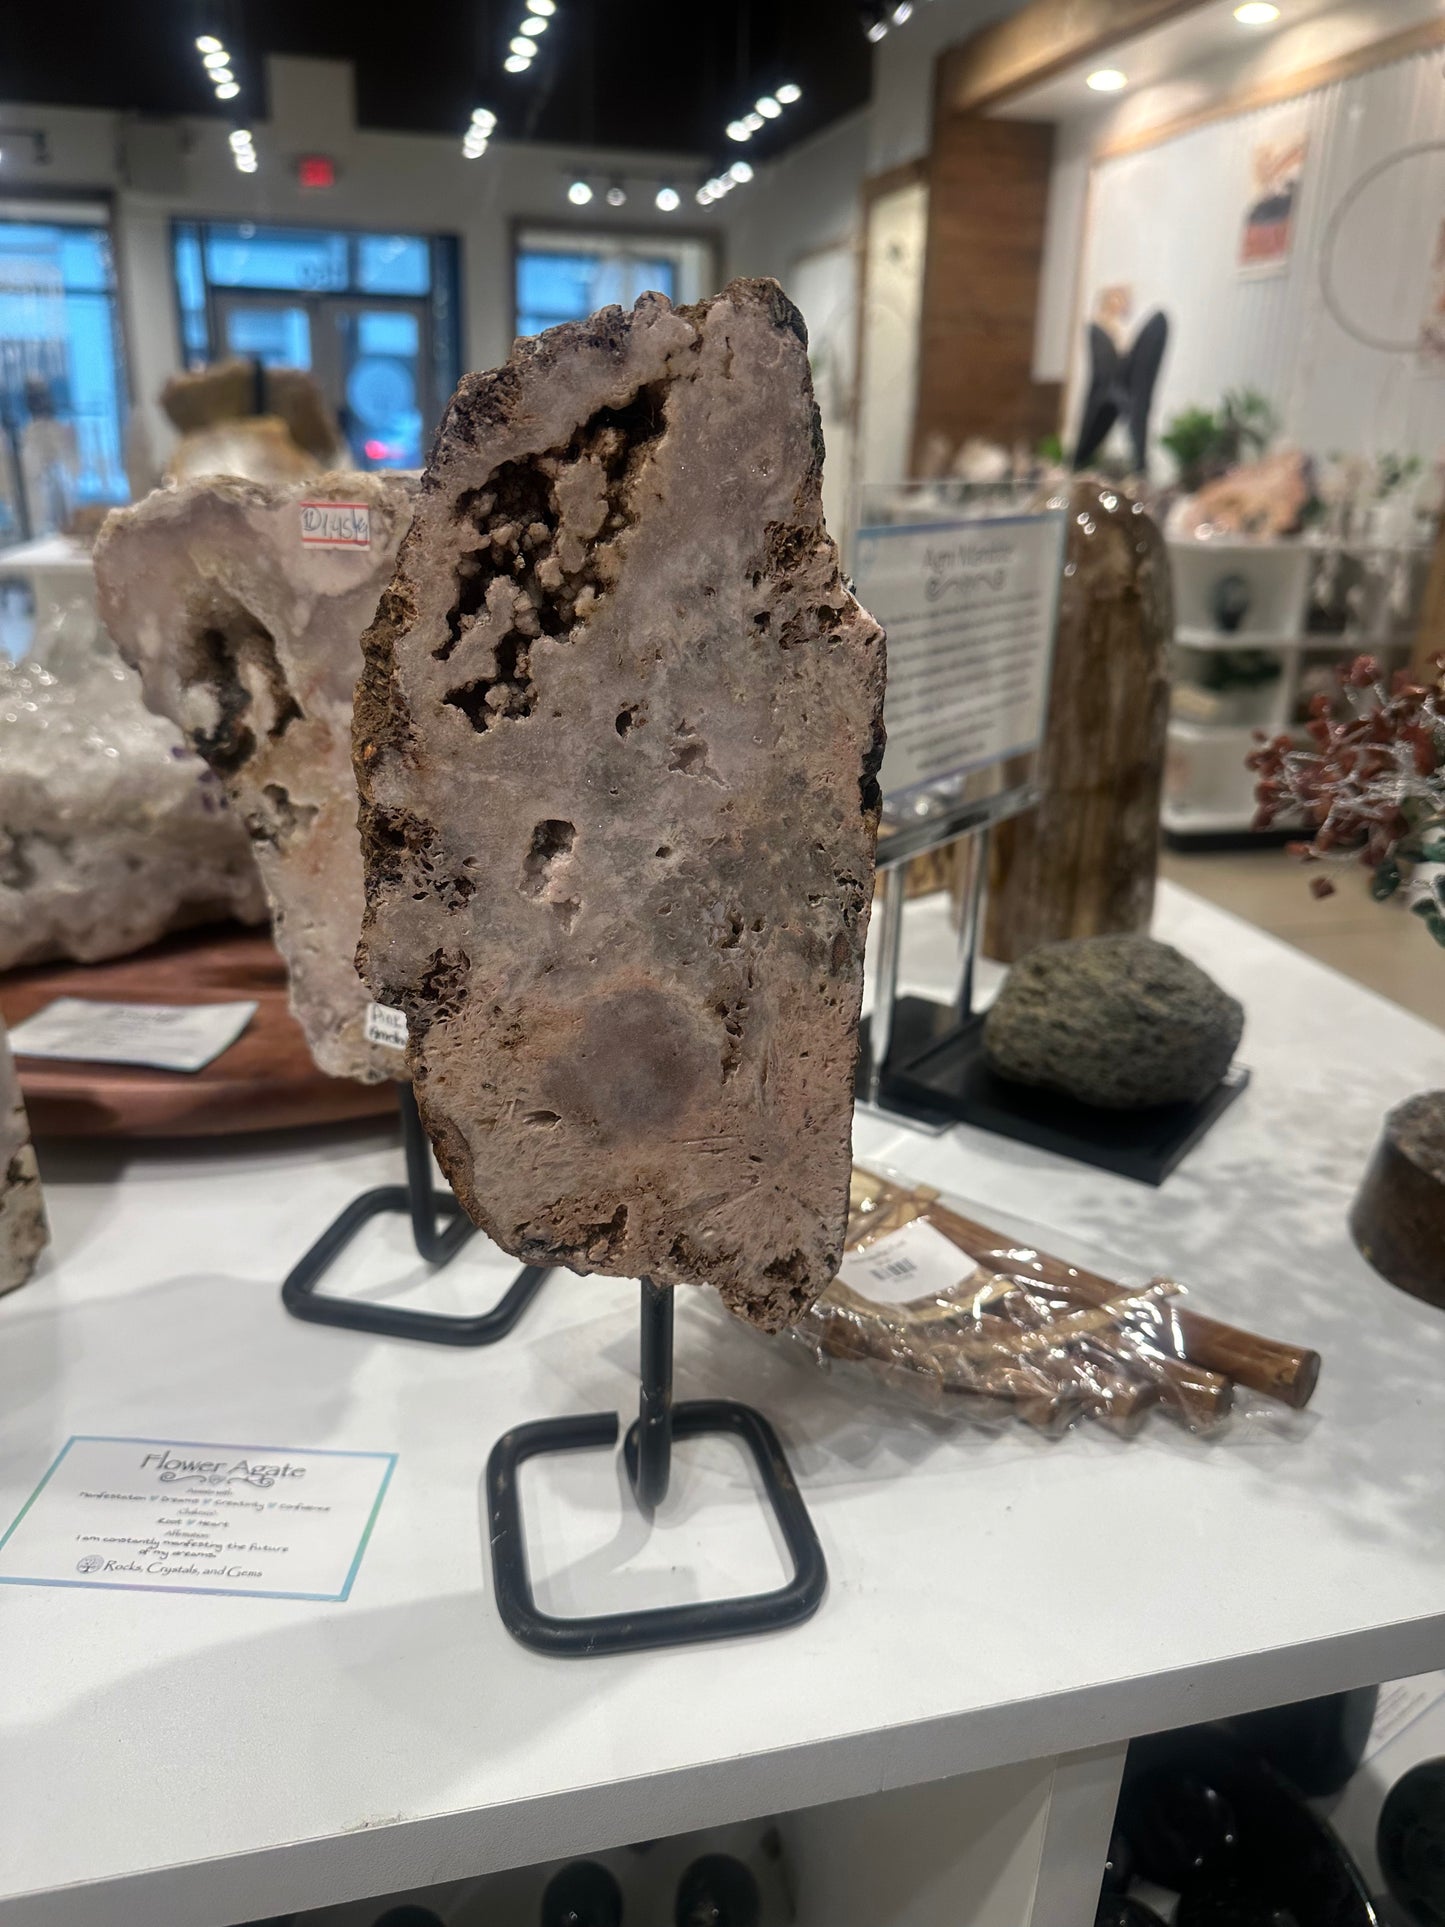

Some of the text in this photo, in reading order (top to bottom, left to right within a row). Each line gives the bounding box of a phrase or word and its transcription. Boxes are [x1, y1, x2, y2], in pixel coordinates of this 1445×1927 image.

[141, 1450, 307, 1485] Flower Agate
[103, 1536, 160, 1549] constantly
[163, 1539, 223, 1552] manifesting
[227, 1541, 247, 1550] the
[248, 1542, 289, 1552] future
[103, 1560, 263, 1577] Rocks, Crystals, and Gems
